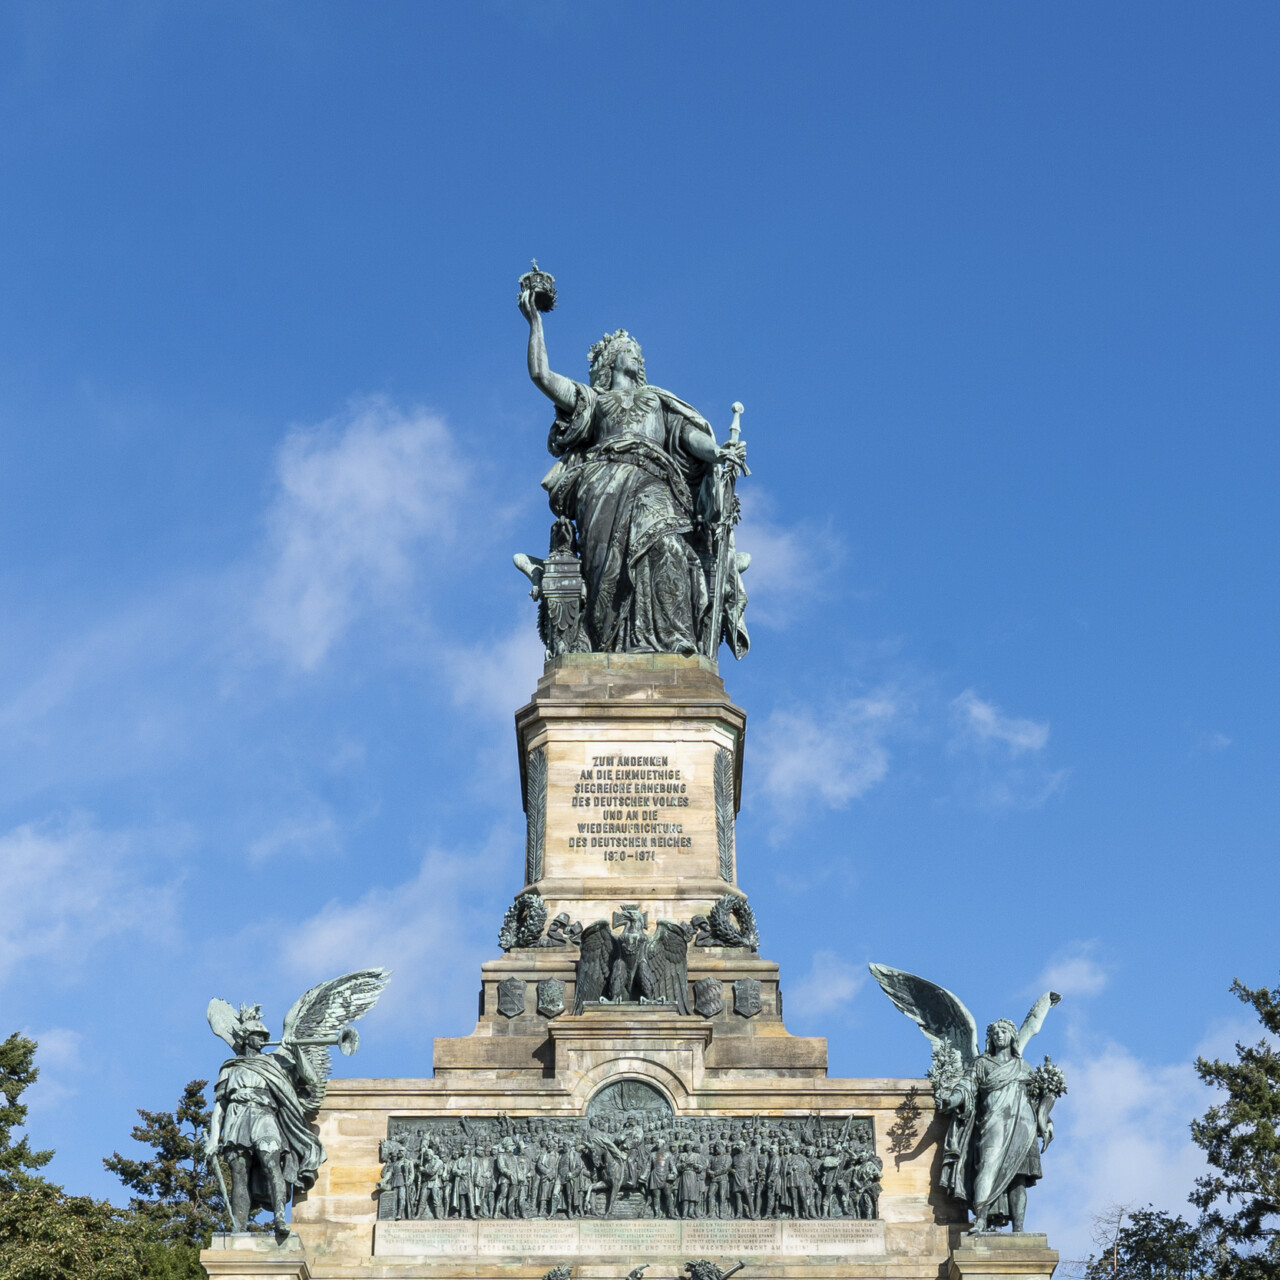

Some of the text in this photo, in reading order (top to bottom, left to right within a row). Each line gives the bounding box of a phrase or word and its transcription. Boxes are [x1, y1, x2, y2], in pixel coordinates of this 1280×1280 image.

[592, 756, 668, 767] ZUM ANDENKEN
[580, 770, 680, 780] AN DIE EINMUETHIGE
[574, 783, 687, 794] SIEGREICHE ERHEBUNG
[572, 797, 689, 807] DES DEUTSCHEN VOLKES
[603, 810, 658, 821] UND AN DIE
[577, 823, 683, 834] WIEDERAUFRICHTUNG
[569, 837, 692, 848] DES DEUTSCHEN REICHES
